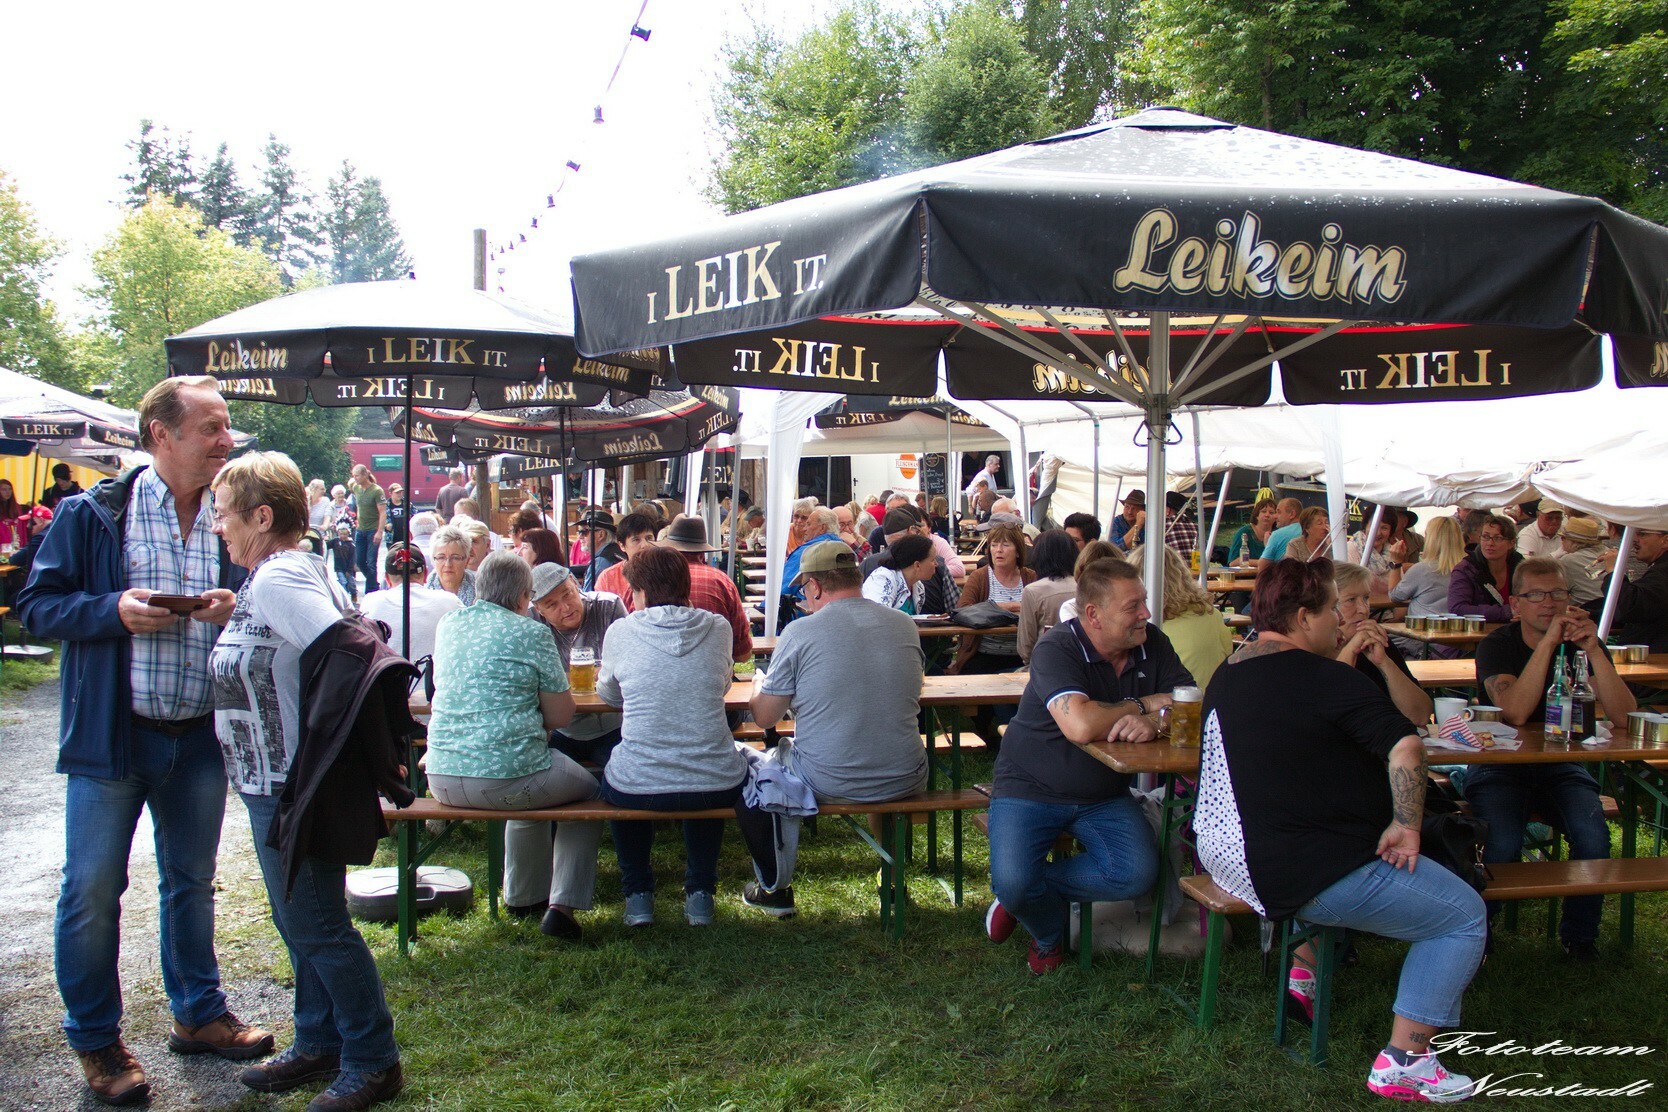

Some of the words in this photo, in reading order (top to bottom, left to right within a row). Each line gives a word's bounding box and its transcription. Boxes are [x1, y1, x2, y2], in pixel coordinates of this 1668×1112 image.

[1113, 207, 1408, 305] Leikeim
[647, 292, 658, 324] I
[664, 240, 782, 321] LEIK
[793, 254, 827, 297] IT.
[205, 338, 289, 373] Leikeim
[367, 348, 376, 364] I
[382, 337, 475, 364] LEIK
[483, 350, 507, 367] IT.
[22, 424, 61, 435] LEIK
